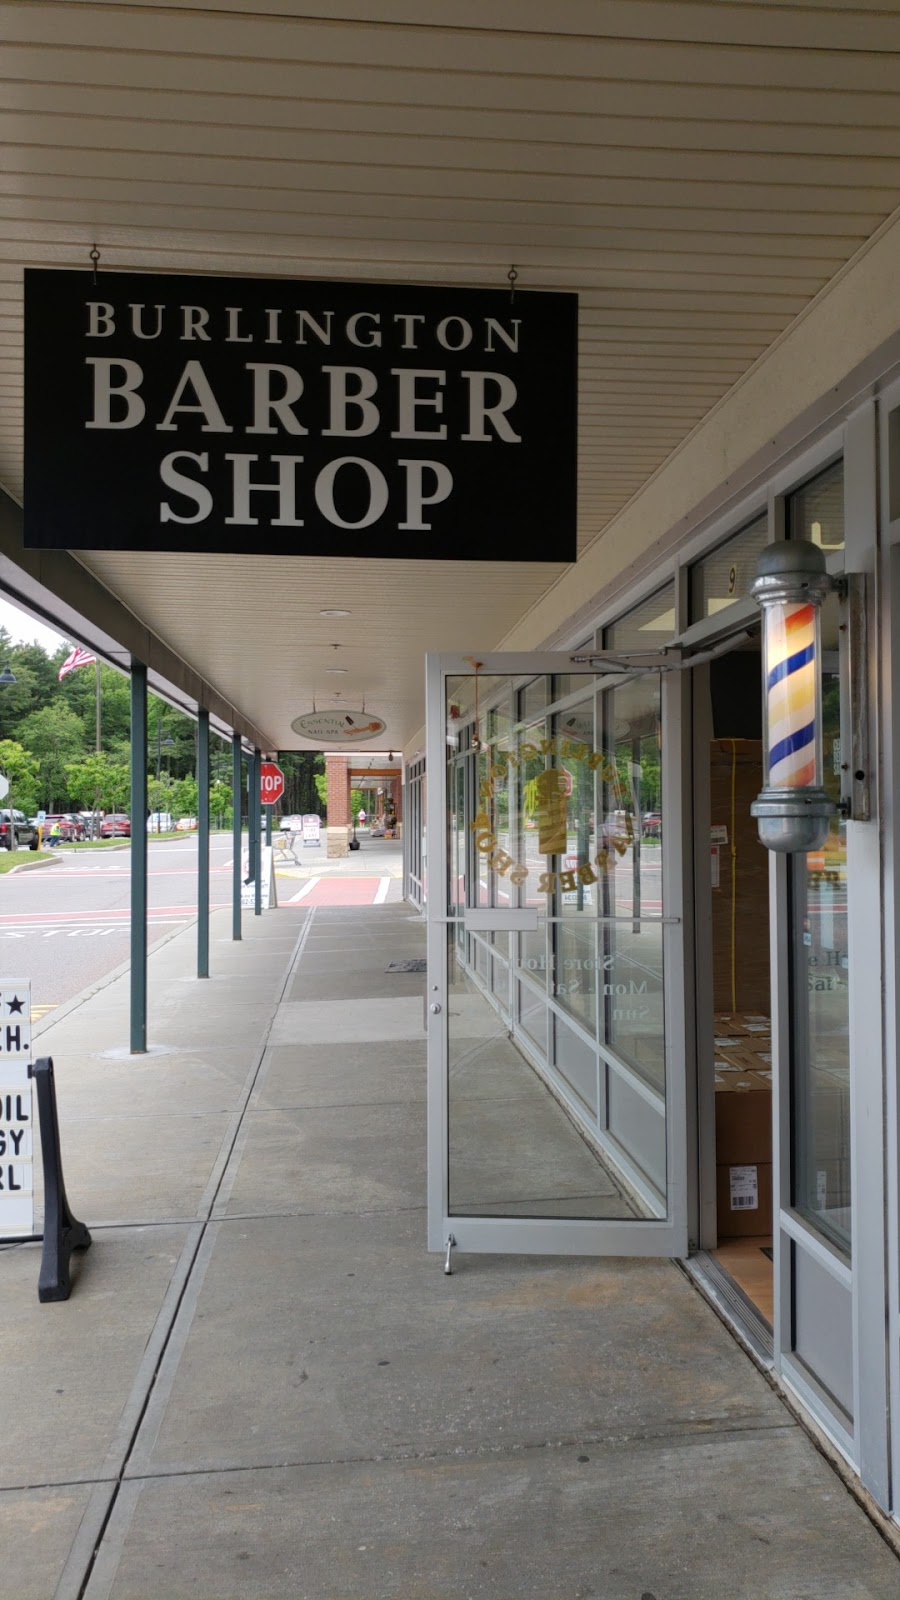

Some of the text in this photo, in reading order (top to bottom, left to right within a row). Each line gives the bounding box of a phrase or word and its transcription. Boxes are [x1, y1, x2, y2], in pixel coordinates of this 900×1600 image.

[84, 301, 523, 353] BURLINGTON
[84, 356, 522, 443] BARBER
[158, 450, 454, 531] SHOP
[728, 567, 736, 593] 9
[260, 775, 282, 791] TOP
[0, 1025, 29, 1052] H.
